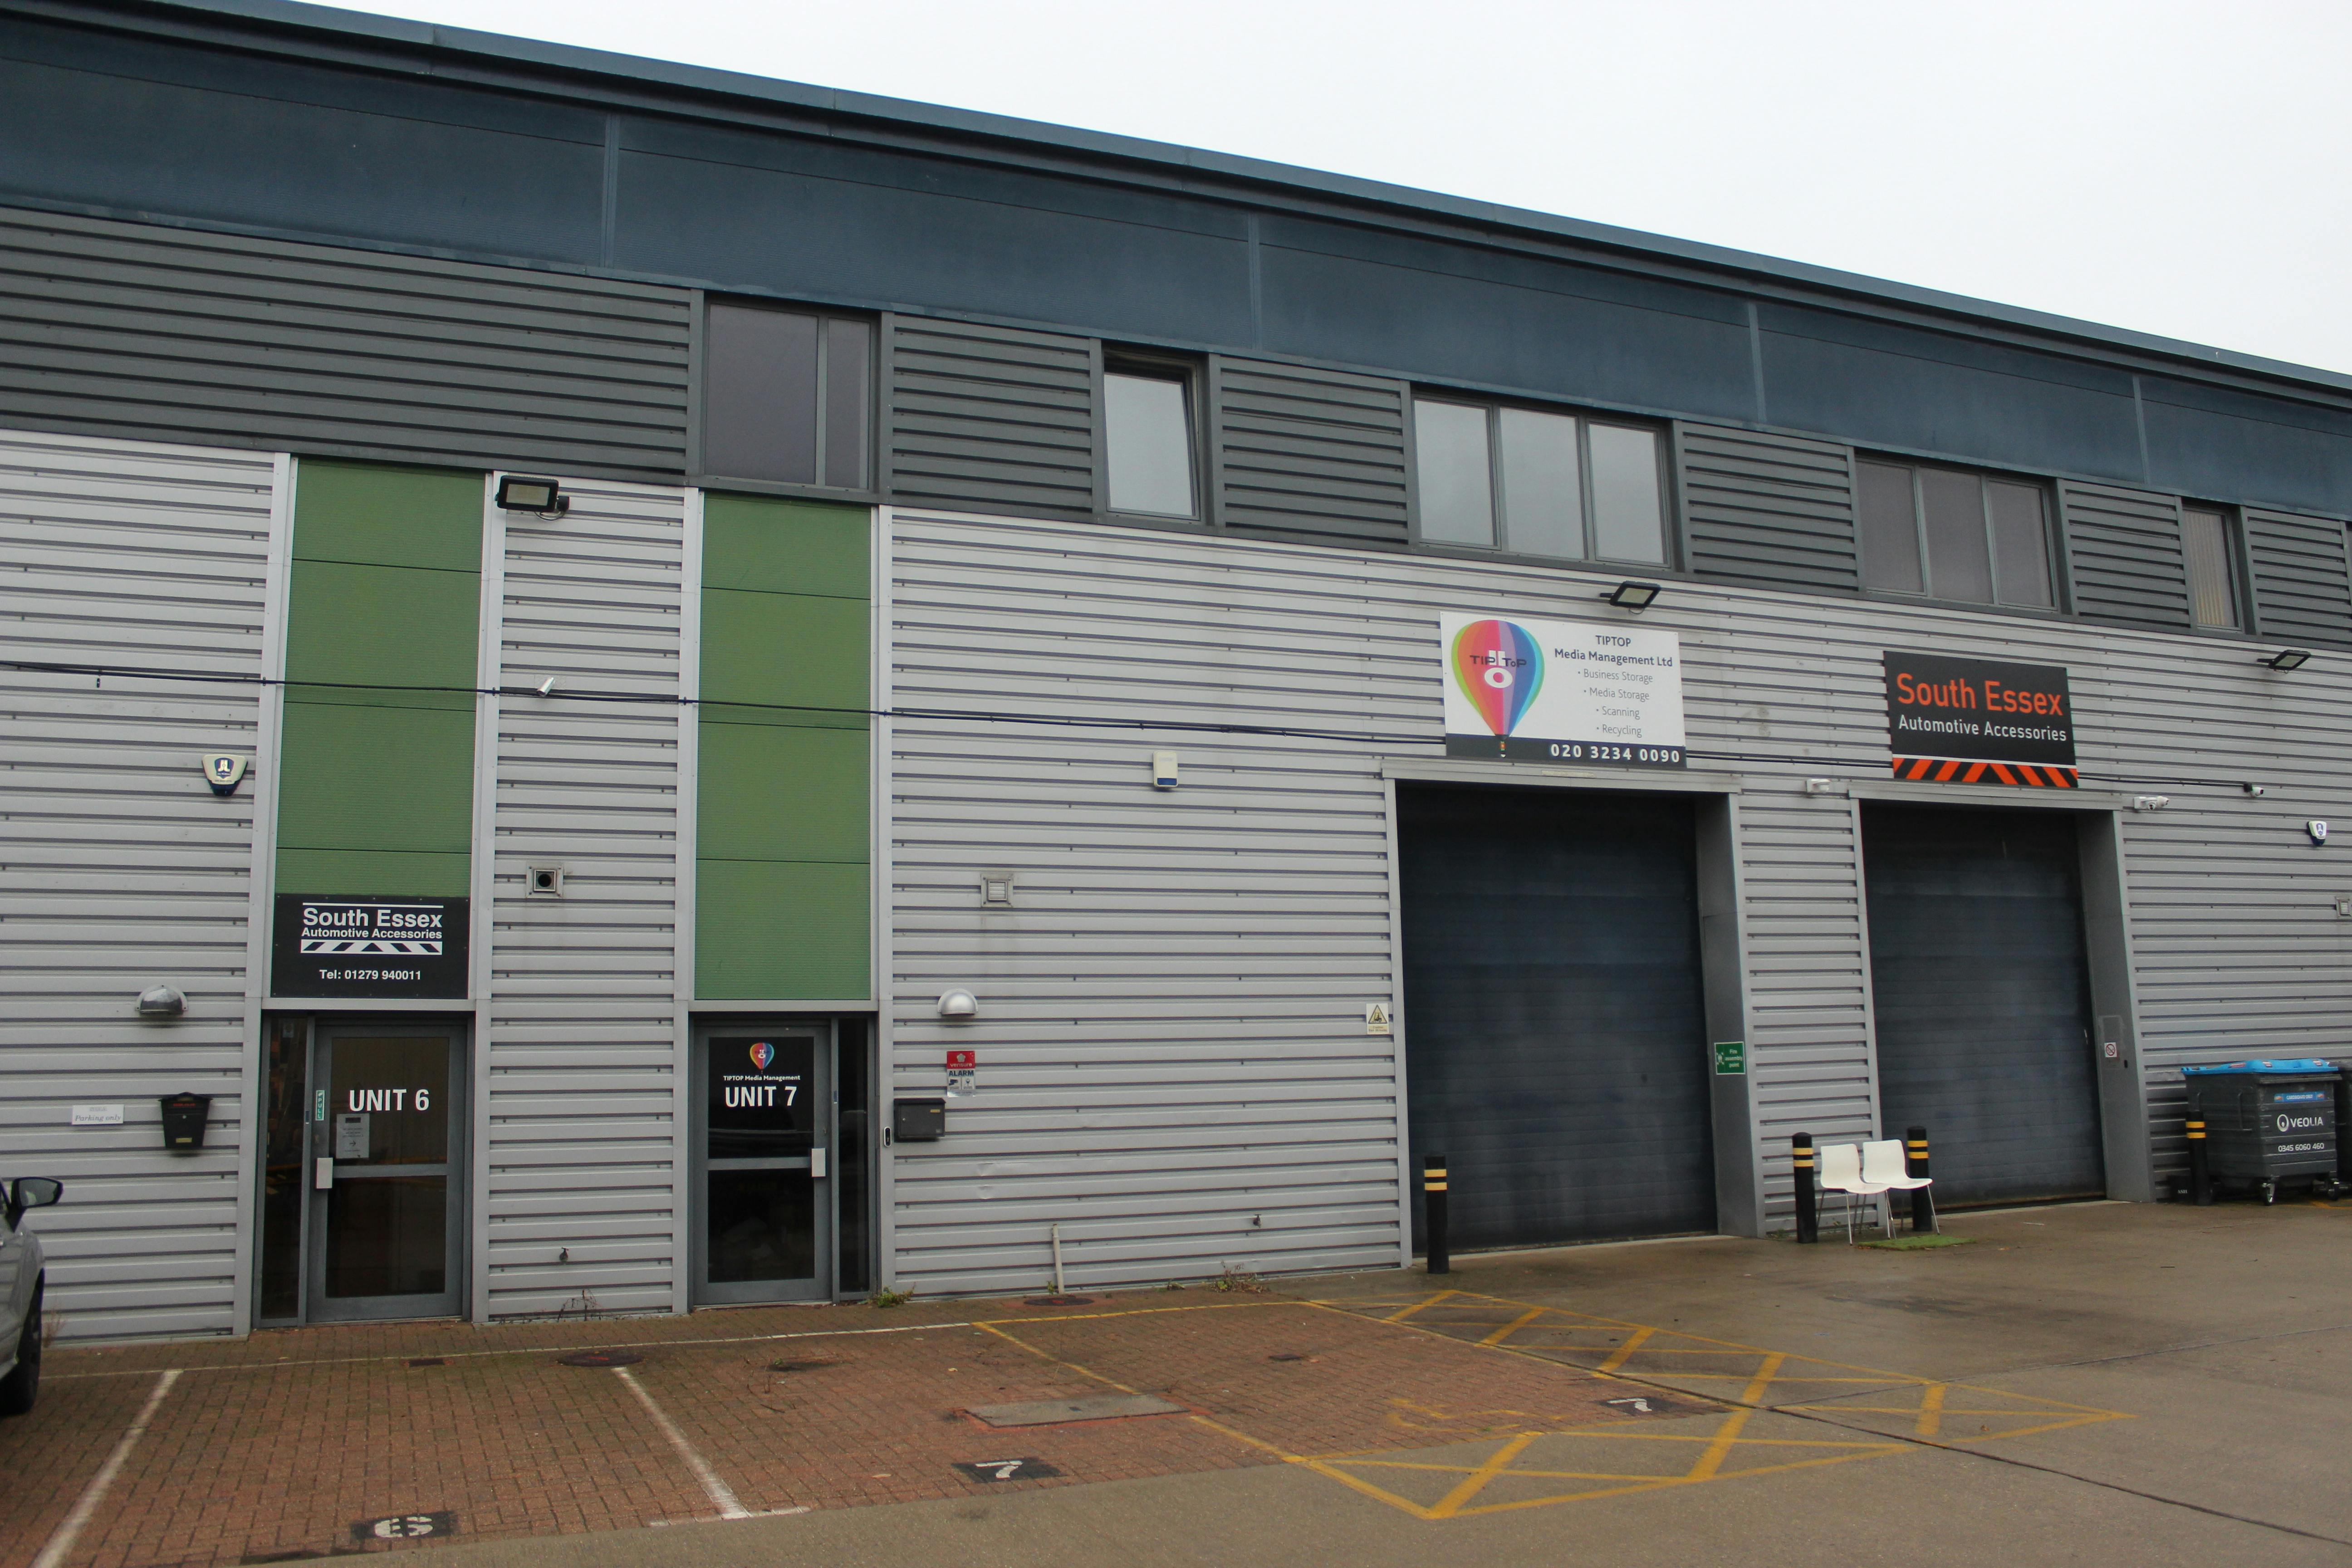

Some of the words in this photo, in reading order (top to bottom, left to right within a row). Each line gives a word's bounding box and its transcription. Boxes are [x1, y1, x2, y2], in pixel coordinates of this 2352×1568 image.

[1595, 635, 1632, 647] TIPTOP
[1554, 648, 1586, 661] Media
[1589, 650, 1655, 666] Management
[1657, 653, 1673, 667] Ltd
[1583, 668, 1619, 681] Business
[1622, 671, 1653, 684] Storage
[1590, 687, 1616, 698] Media
[1619, 690, 1650, 701] Storage
[1896, 672, 1976, 709] South
[1984, 680, 2063, 716] Essex
[1602, 706, 1640, 719] Scanning
[1602, 724, 1642, 738] Recycling
[1899, 714, 1979, 735] Automotive
[1984, 721, 2067, 741] Accessories
[1550, 743, 1582, 758] 020
[1590, 745, 1632, 761] 3234
[1639, 748, 1680, 763] 0090
[303, 907, 368, 926] South
[377, 909, 443, 928] Essex
[302, 927, 369, 938] Automotive
[372, 928, 442, 939] Accessories
[319, 969, 341, 979] Tel:
[344, 970, 378, 980] 01279
[382, 970, 421, 980] 940011
[349, 1089, 407, 1112] UNIT
[415, 1088, 429, 1111] 6
[725, 1086, 777, 1107] UNIT
[784, 1086, 797, 1107] 7
[2290, 1117, 2323, 1127] VEOLIA
[1607, 1397, 1653, 1412] 7
[975, 1460, 1024, 1479] 7
